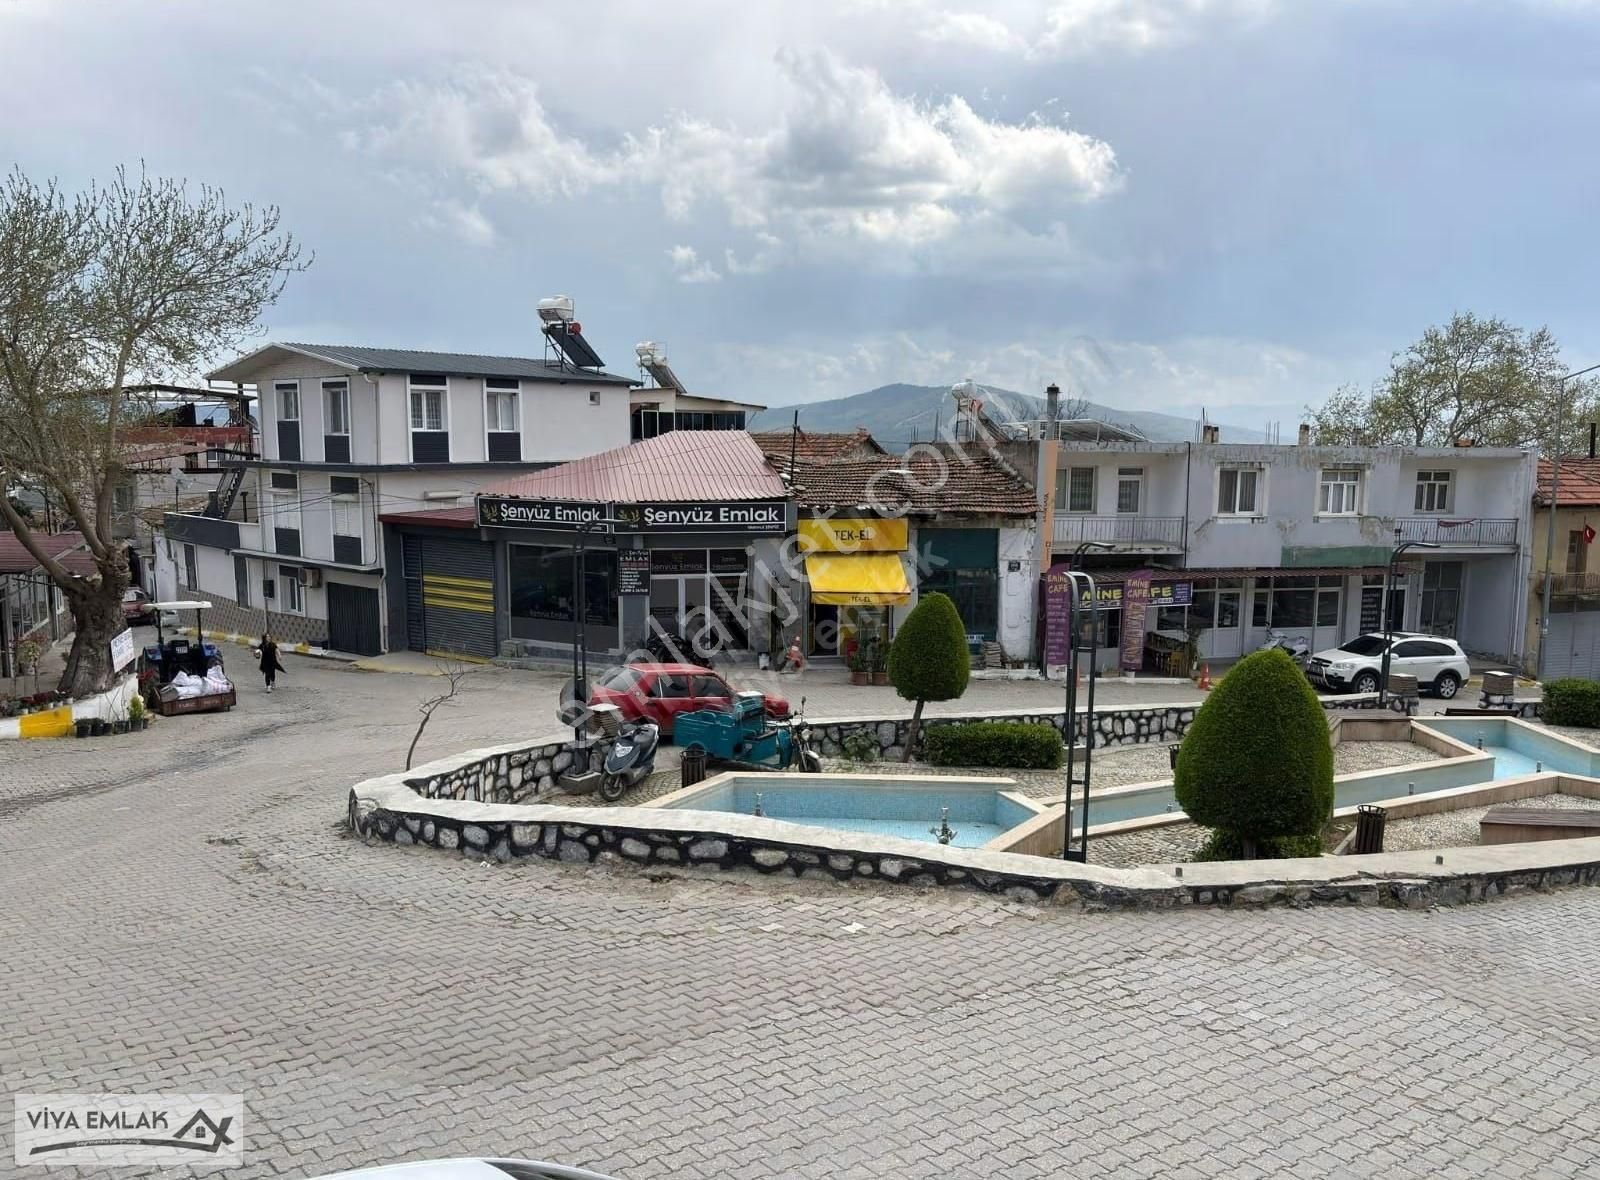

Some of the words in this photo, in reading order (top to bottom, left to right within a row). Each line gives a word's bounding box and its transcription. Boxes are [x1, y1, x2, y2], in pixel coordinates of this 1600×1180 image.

[500, 502, 551, 522] Şenyüz
[554, 505, 600, 522] Emlak
[643, 506, 713, 527] Şenyüz
[719, 506, 779, 522] Emlak
[833, 530, 872, 541] TEK-EL
[1048, 584, 1068, 594] CAFE
[1127, 577, 1151, 589] EMİNE
[1081, 586, 1123, 600] MİNE
[1149, 586, 1172, 598] FE
[1127, 589, 1149, 599] CAFE
